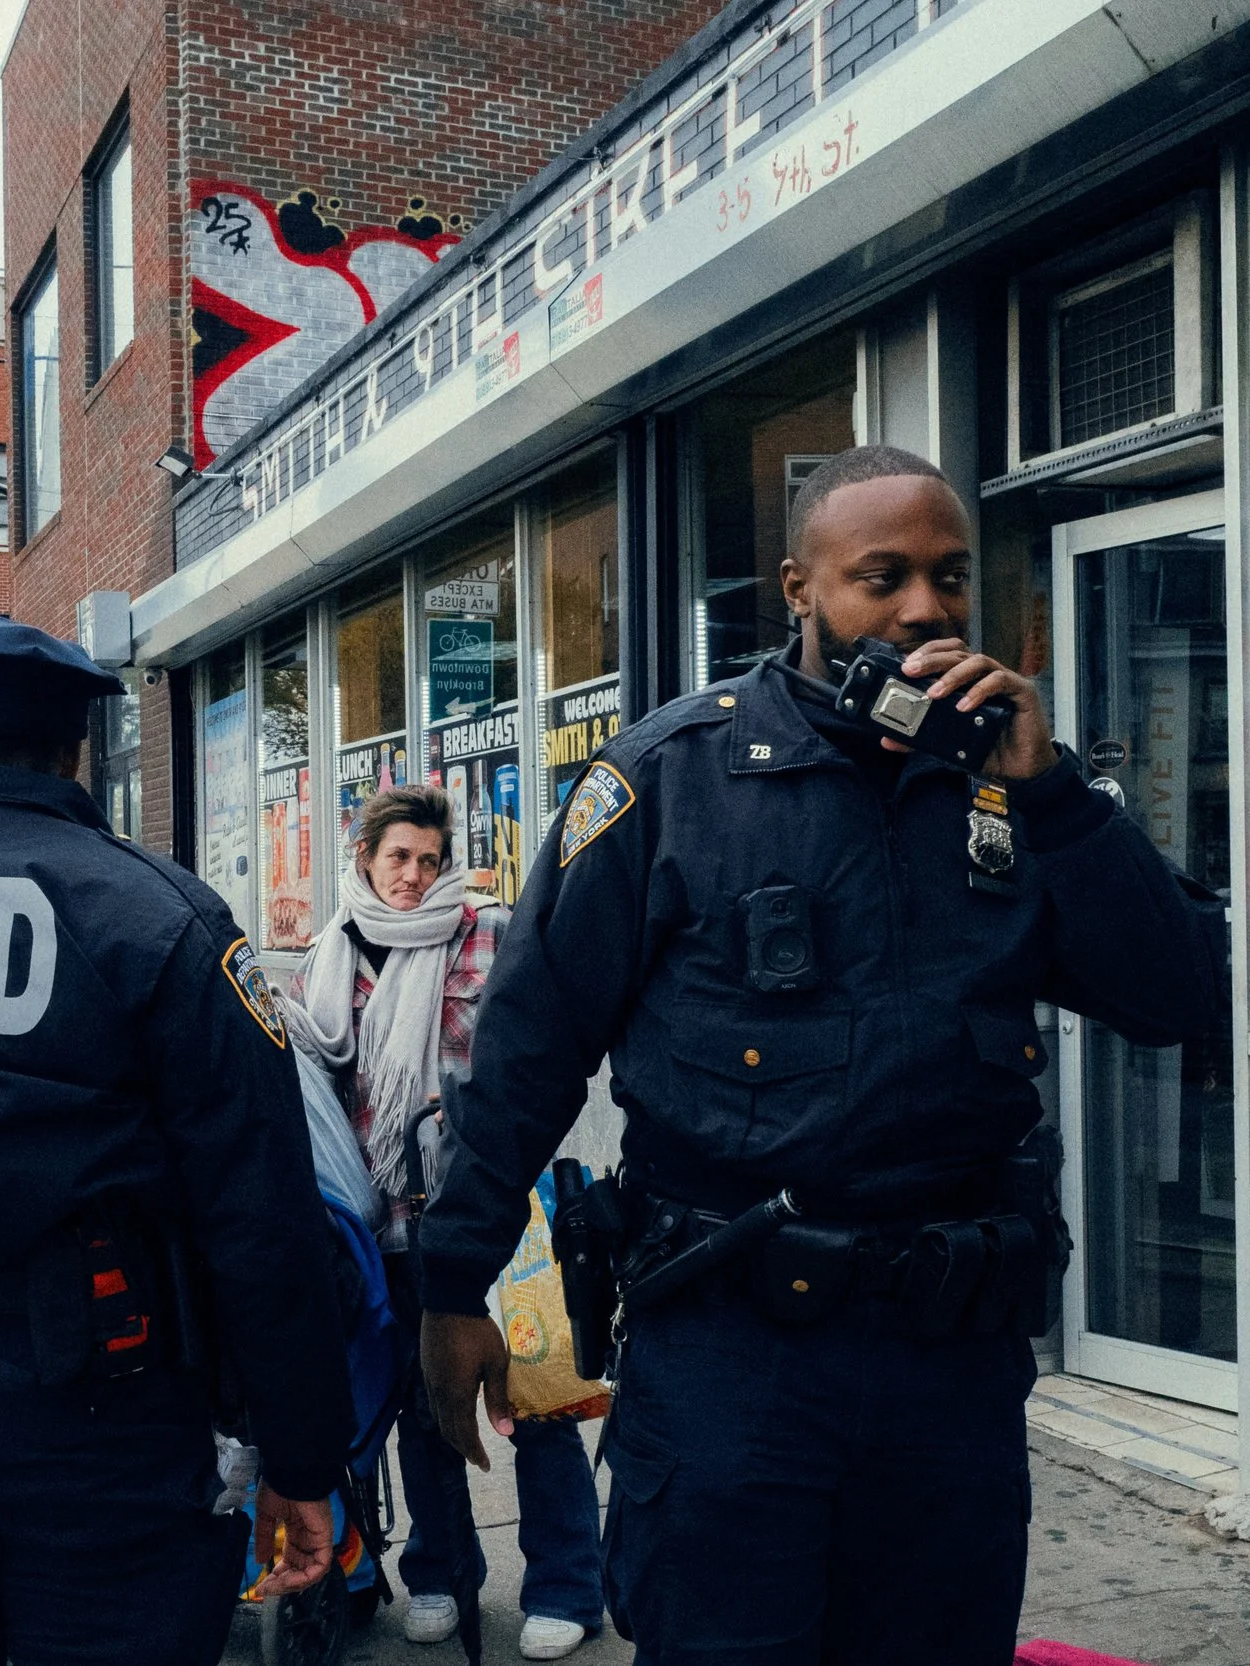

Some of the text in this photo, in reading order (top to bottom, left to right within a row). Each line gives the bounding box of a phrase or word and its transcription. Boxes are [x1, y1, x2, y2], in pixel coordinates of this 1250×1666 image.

[443, 712, 519, 760] BREAKFAST
[543, 722, 587, 768] SMITH
[338, 749, 372, 782] LUNCH
[594, 769, 619, 792] POLICE
[262, 768, 297, 802] DINNER
[582, 816, 609, 840] YORK
